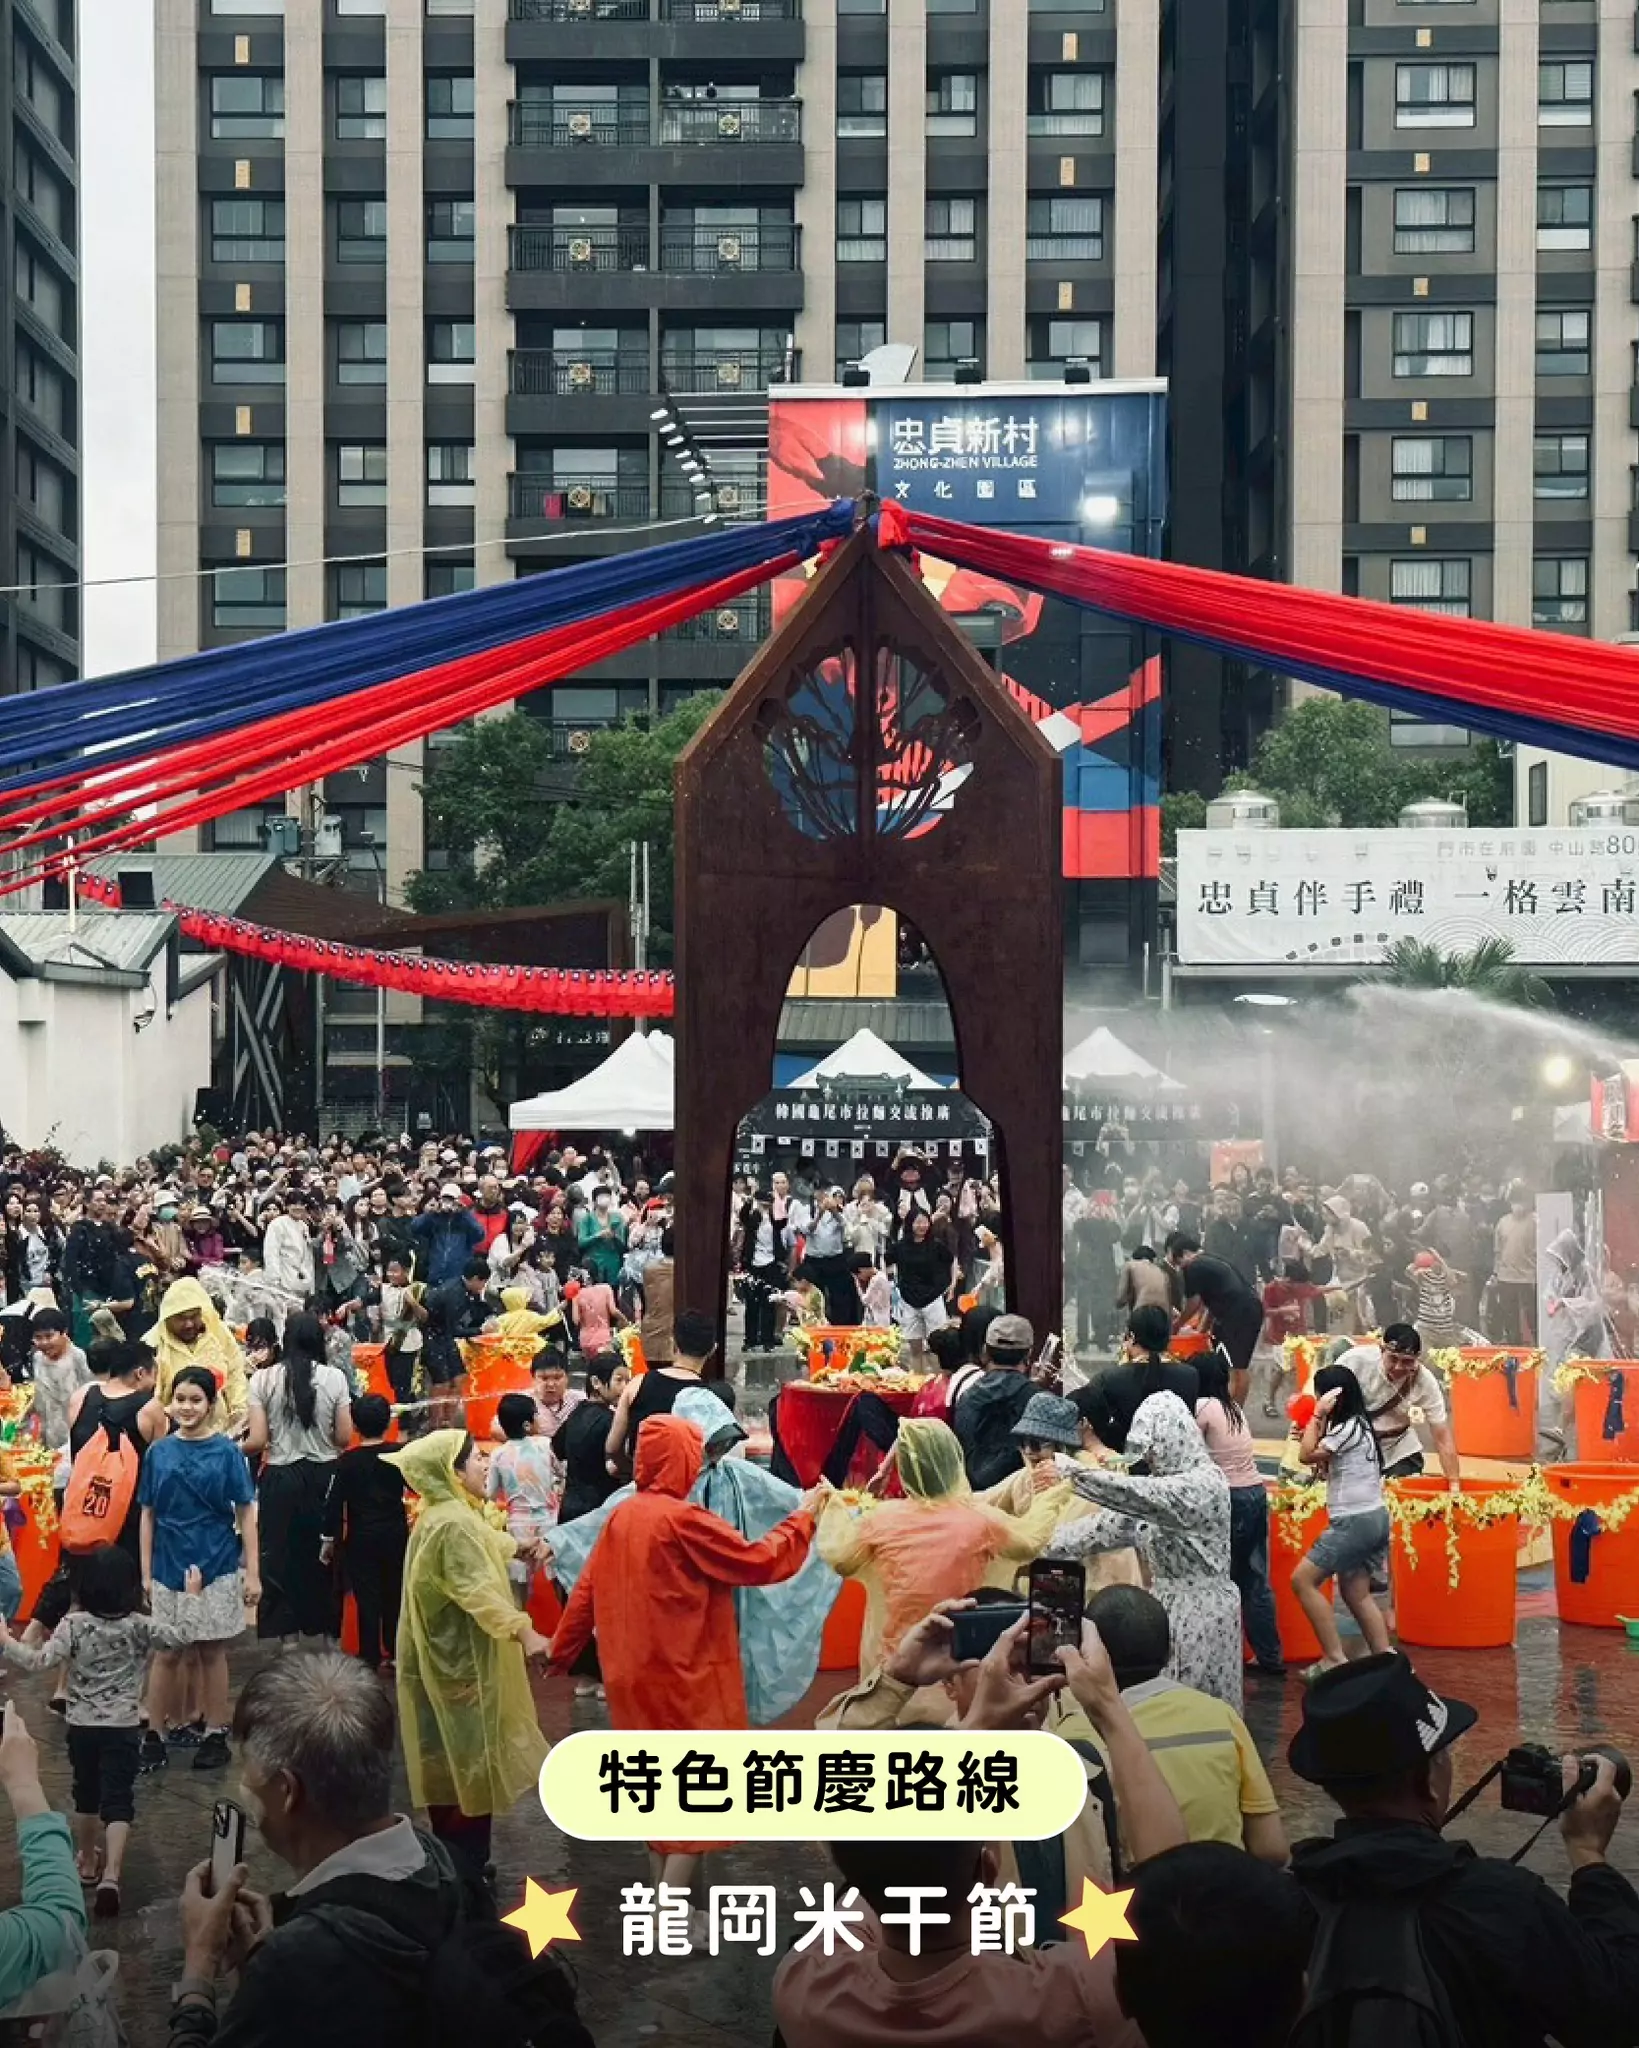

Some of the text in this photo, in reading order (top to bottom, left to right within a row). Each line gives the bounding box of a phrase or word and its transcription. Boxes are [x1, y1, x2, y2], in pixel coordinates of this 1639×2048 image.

[893, 416, 1038, 455] 忠貞新村
[893, 455, 1038, 470] ZHONG-ZHEN VILLAGE
[895, 480, 1037, 499] 文化園區
[1199, 878, 1636, 915] 忠貞伴手禮 一格雲南
